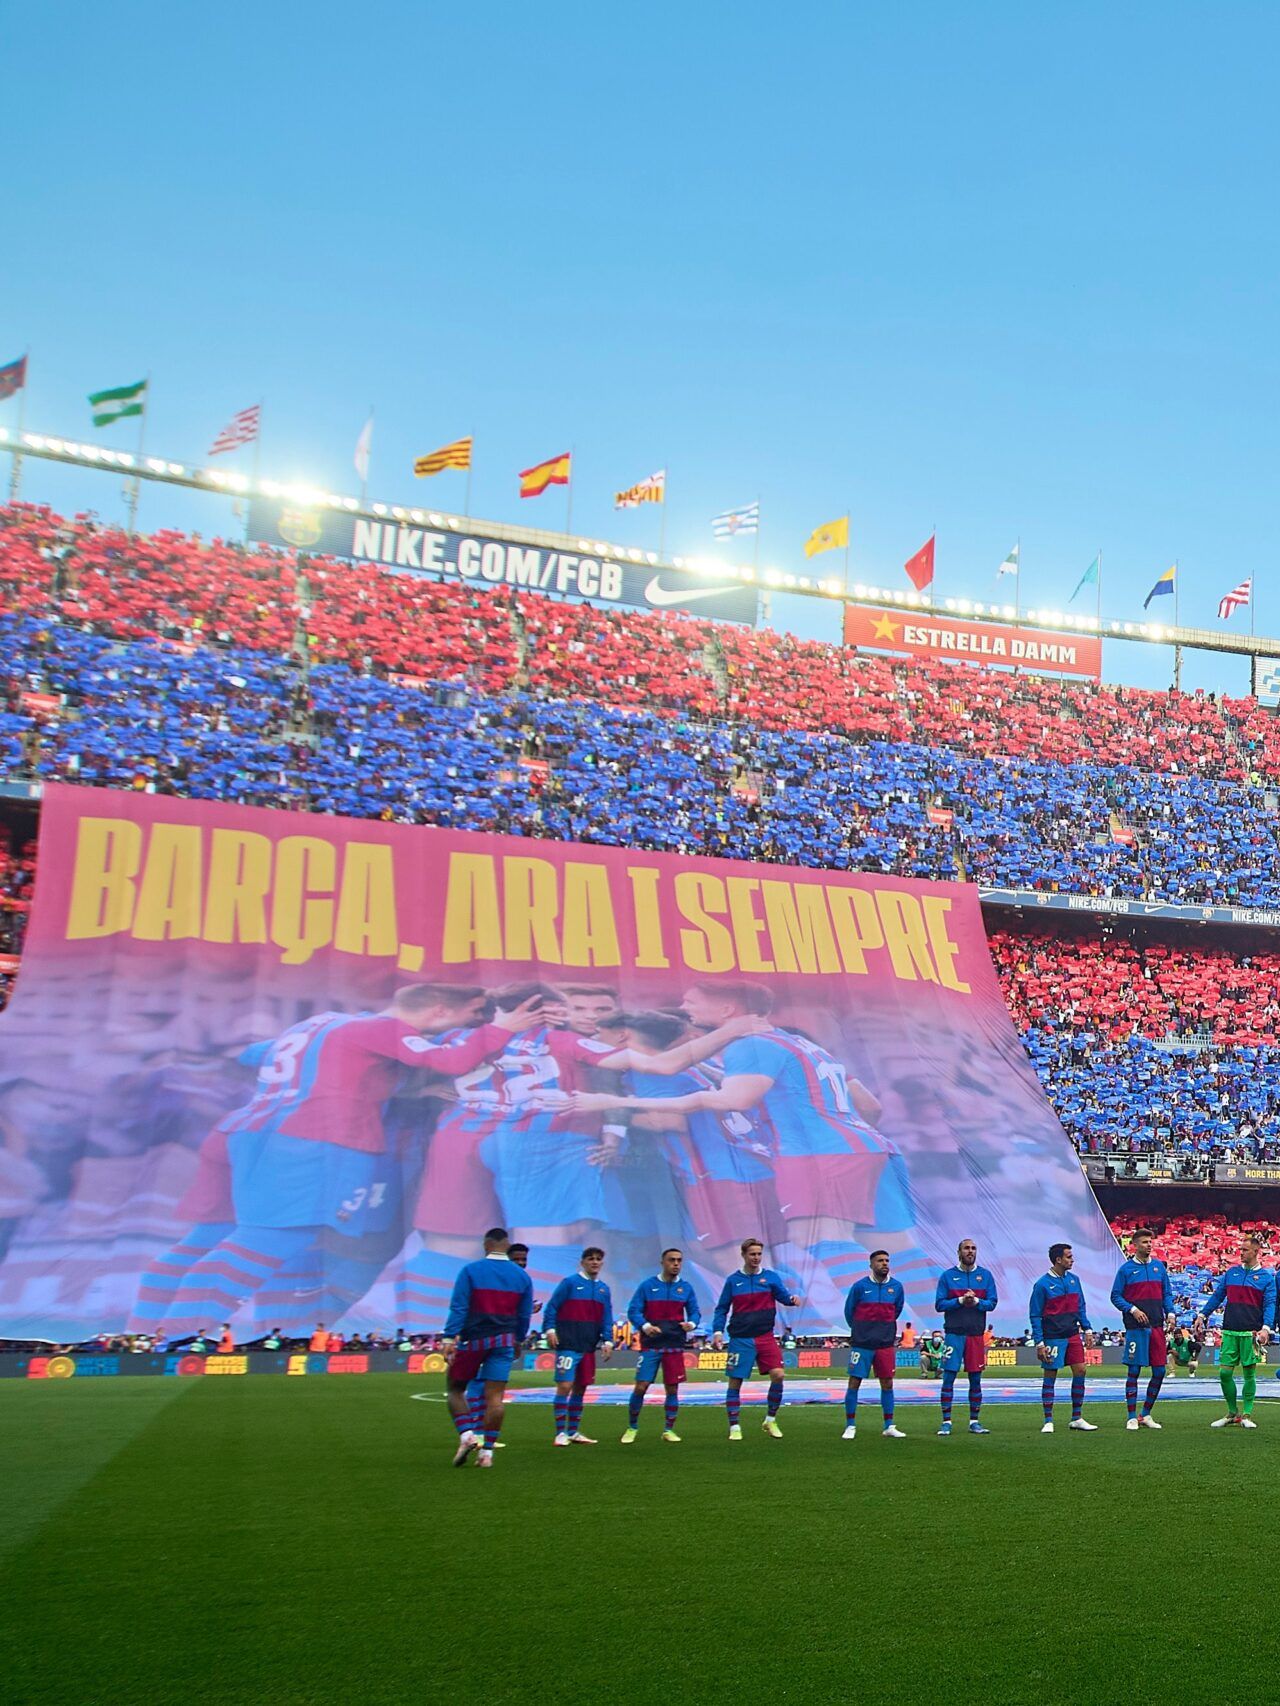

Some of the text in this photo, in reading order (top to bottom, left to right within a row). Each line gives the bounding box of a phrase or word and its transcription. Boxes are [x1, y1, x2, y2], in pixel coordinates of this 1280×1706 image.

[352, 519, 624, 601] NIKE.COM/FCB
[903, 625, 1077, 665] ESTRELLA DAMM
[67, 817, 972, 994] BARÇA, ARA I SEMPRE
[1245, 1169, 1266, 1179] MORE
[1129, 1342, 1136, 1354] 3
[556, 1356, 573, 1370] 30
[637, 1356, 643, 1368] 2
[728, 1352, 740, 1366] 21
